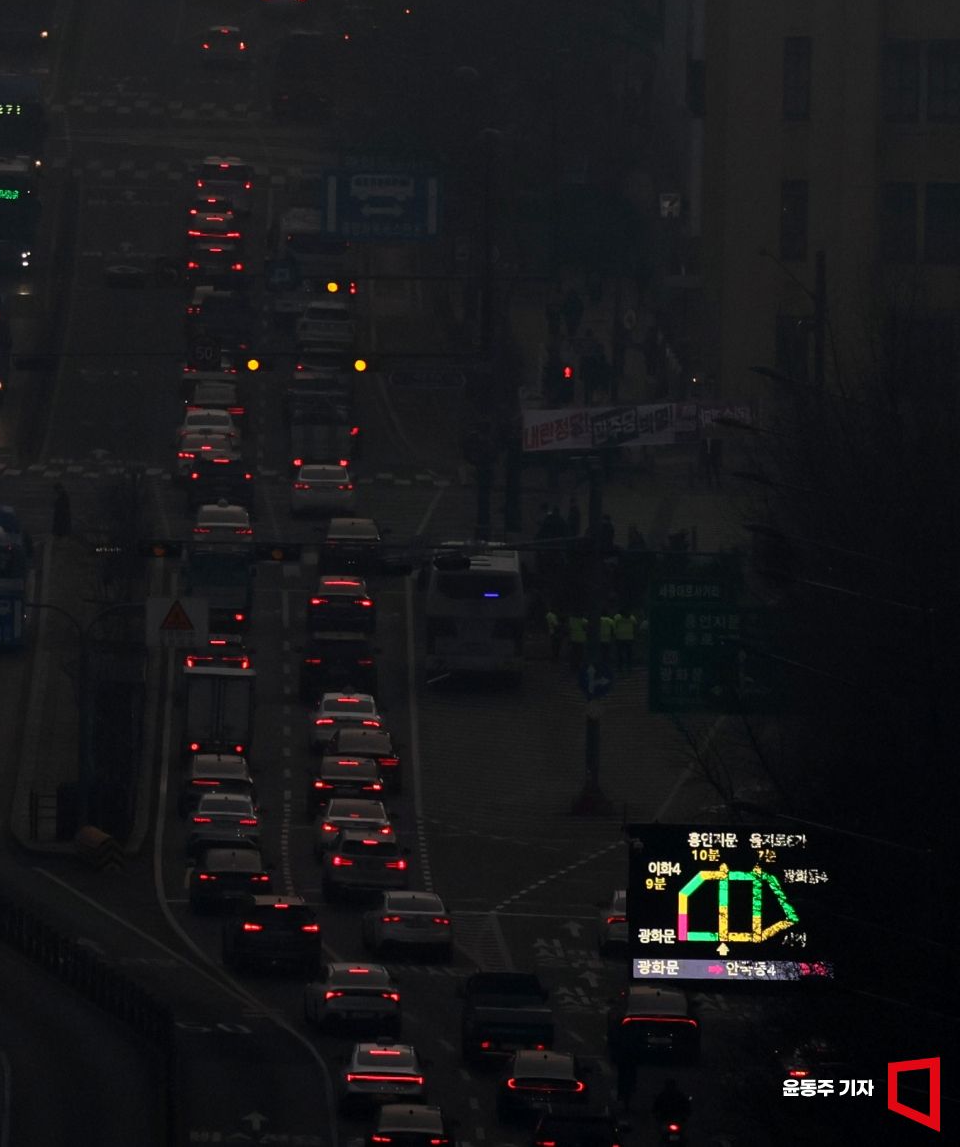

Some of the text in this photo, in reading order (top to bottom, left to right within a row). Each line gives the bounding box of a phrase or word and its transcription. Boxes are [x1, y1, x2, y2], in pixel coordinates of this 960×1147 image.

[687, 832, 738, 848] 흥인지문
[692, 849, 720, 862] 10분
[648, 861, 681, 876] 이화4
[645, 877, 667, 890] 9분
[638, 928, 676, 944] 광화문
[637, 959, 680, 975] 광화문
